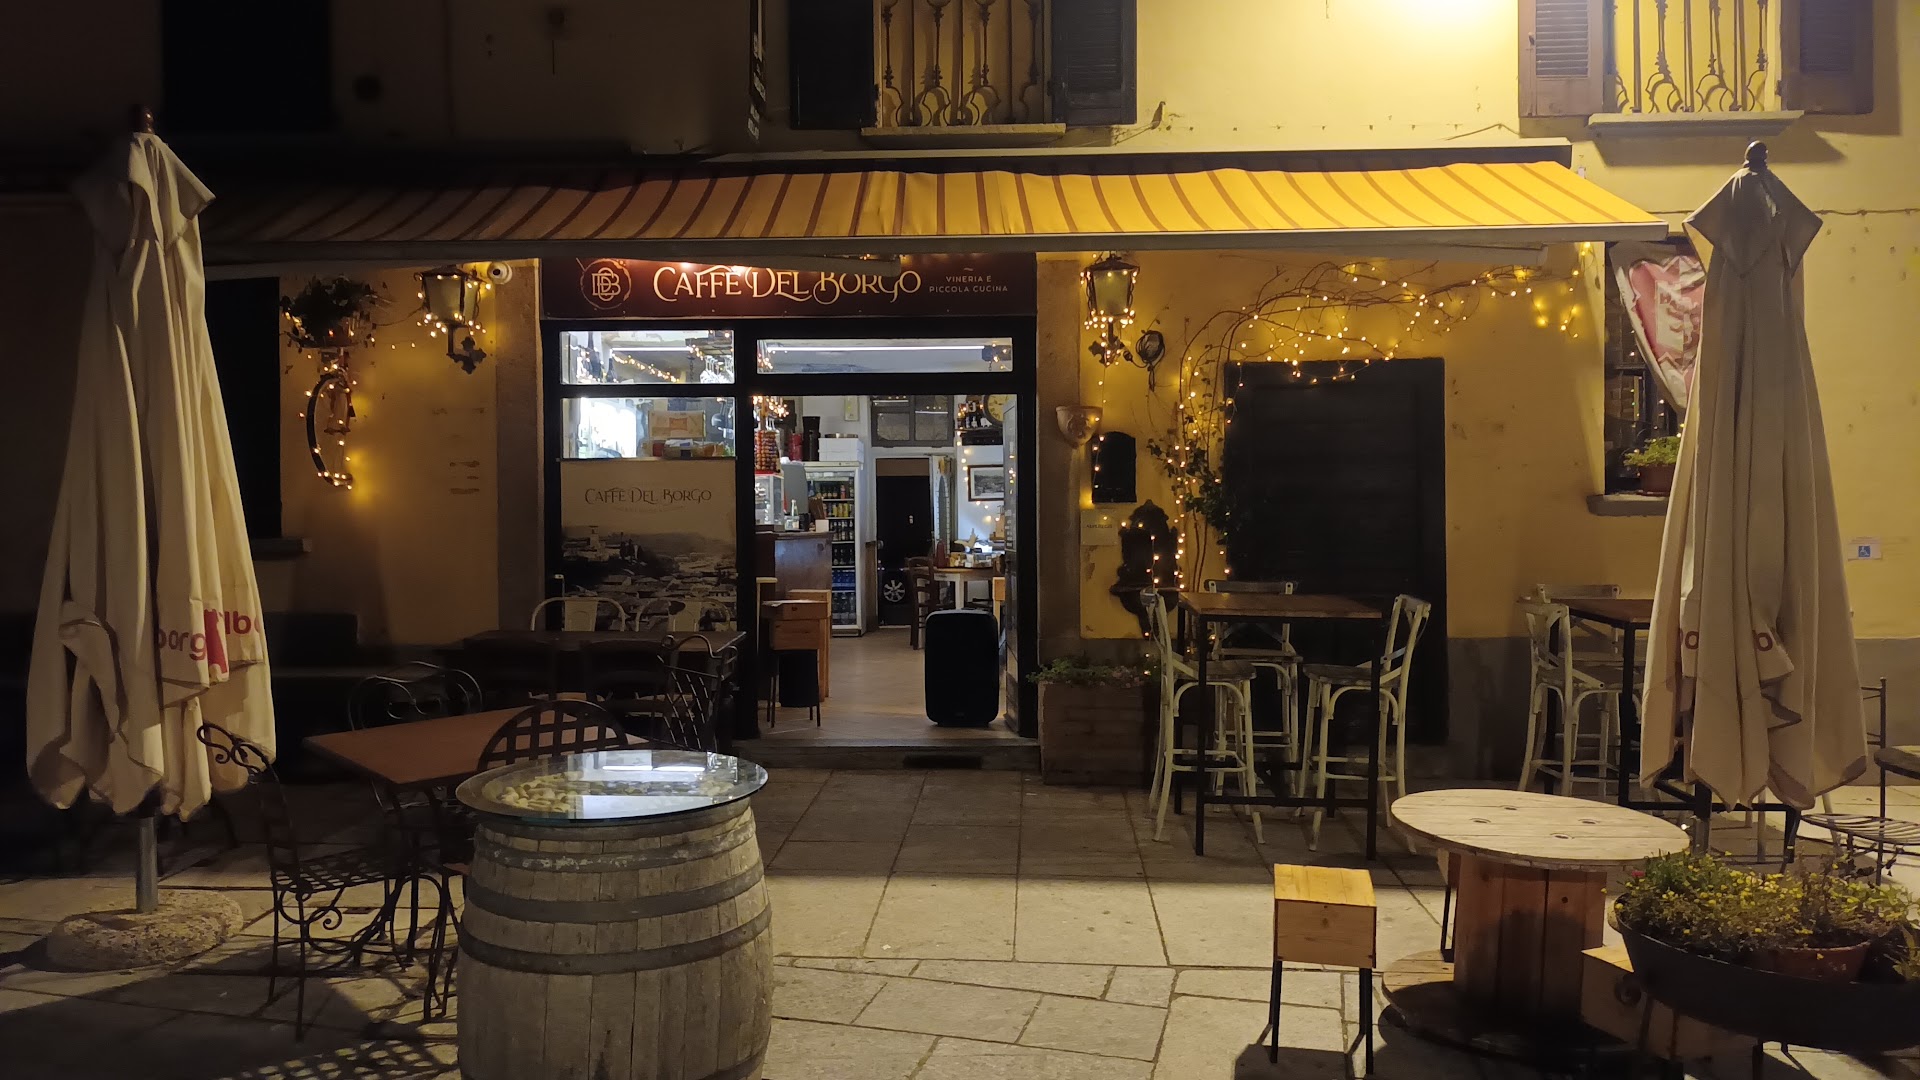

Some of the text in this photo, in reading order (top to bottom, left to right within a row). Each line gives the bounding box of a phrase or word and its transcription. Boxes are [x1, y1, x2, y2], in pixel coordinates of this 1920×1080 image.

[945, 275, 992, 283] VINERIA E
[744, 267, 813, 302] DEL
[813, 270, 922, 305] BORGO
[929, 285, 1008, 293] PICCOLA CUCINA
[630, 487, 659, 505] DEL
[662, 488, 712, 505] BORGO
